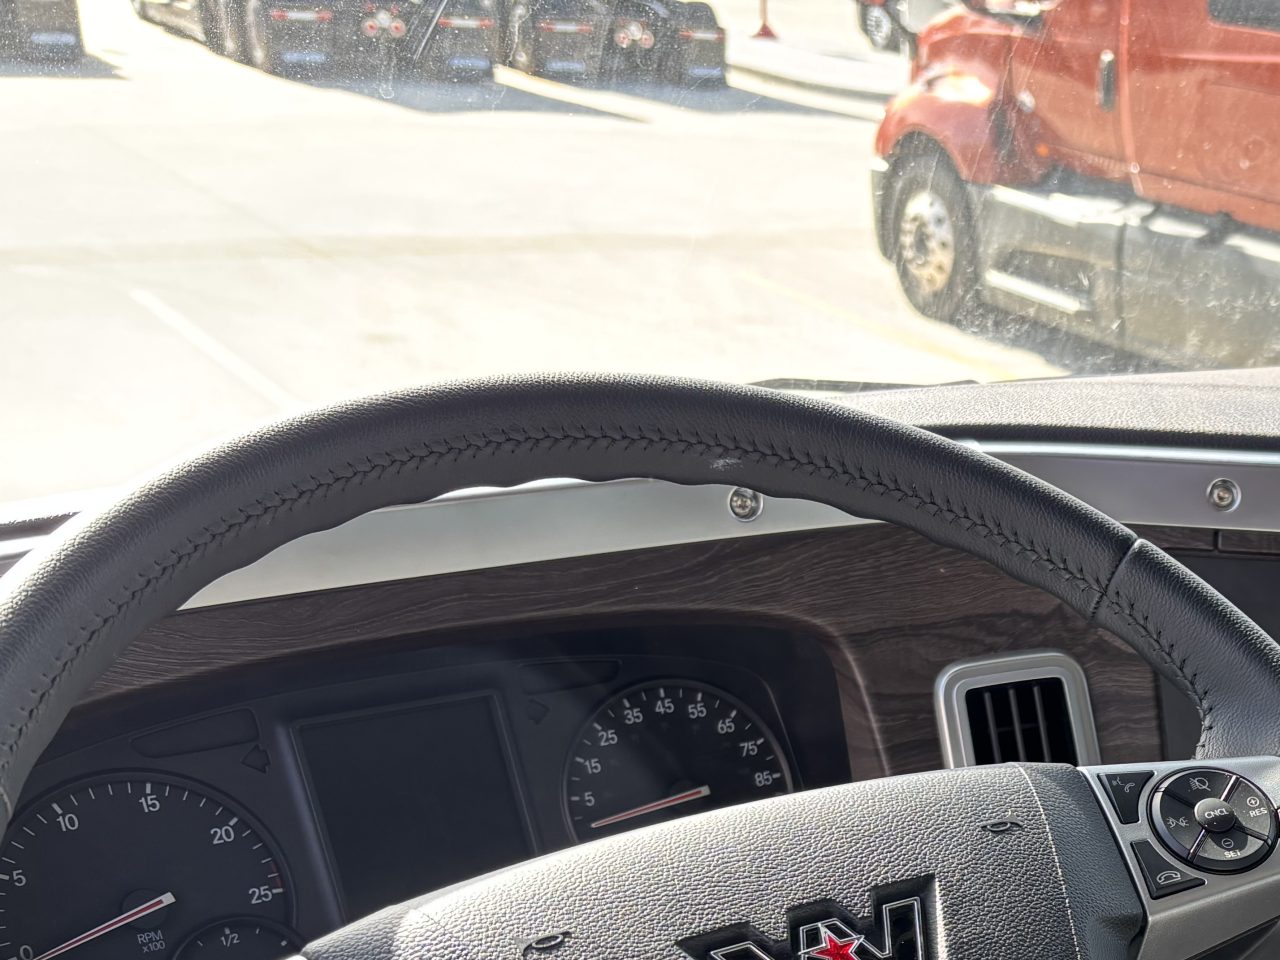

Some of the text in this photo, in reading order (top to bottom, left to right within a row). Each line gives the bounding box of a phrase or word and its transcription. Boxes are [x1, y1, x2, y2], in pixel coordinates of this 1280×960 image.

[655, 698, 675, 715] 45
[688, 702, 707, 719] 55
[624, 708, 643, 725] 35
[717, 718, 735, 734] 65
[598, 729, 618, 746] 25
[739, 741, 758, 757] 75
[584, 758, 601, 774] 15
[754, 770, 773, 787] 85
[138, 795, 161, 813] 15
[584, 791, 595, 806] 5
[1204, 808, 1230, 819] CNCL
[1249, 807, 1268, 818] RES
[56, 813, 79, 832] 10
[210, 825, 235, 844] 20
[1224, 850, 1241, 858] SET
[12, 869, 26, 887] 5
[248, 885, 273, 905] 25
[137, 930, 163, 944] RPM
[220, 933, 240, 948] 1/2
